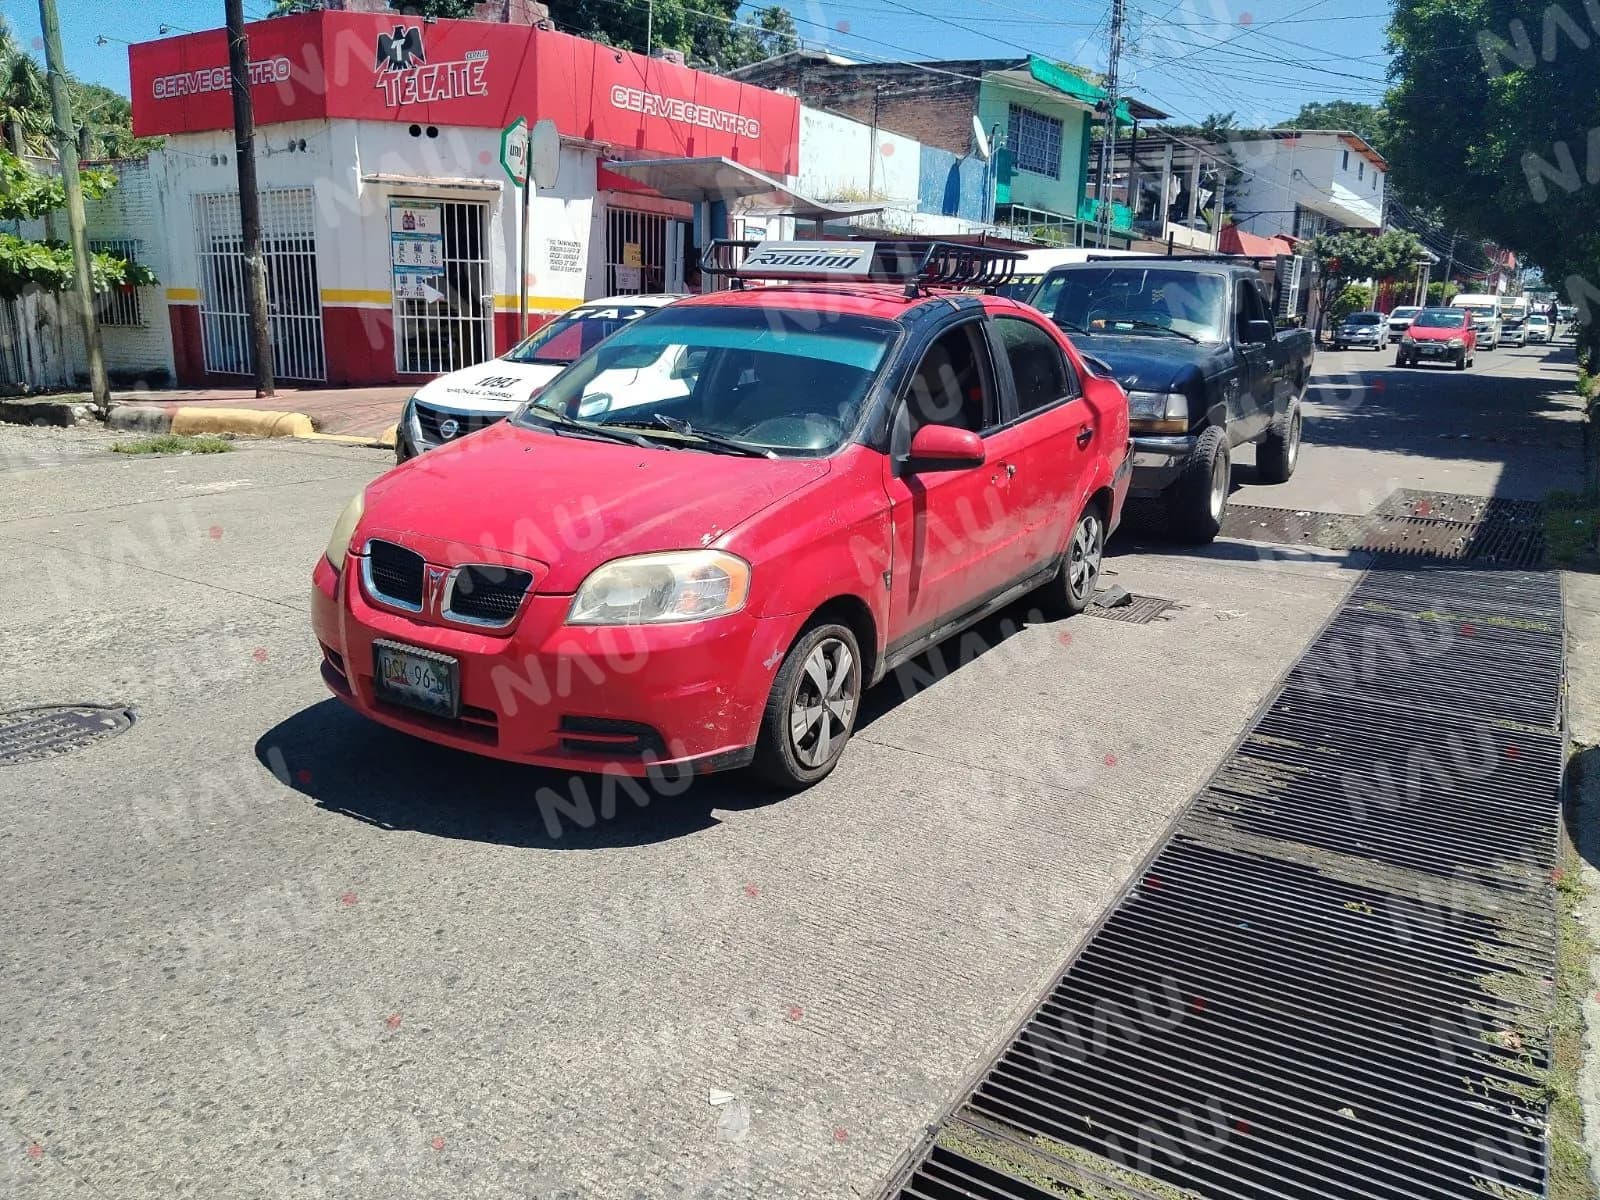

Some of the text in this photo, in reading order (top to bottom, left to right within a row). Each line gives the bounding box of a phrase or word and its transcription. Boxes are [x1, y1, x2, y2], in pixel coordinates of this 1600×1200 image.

[153, 57, 291, 99] CERVECETRO
[376, 59, 488, 107] TECATE
[611, 85, 760, 139] CERVECENTRO
[569, 308, 647, 320] TAX
